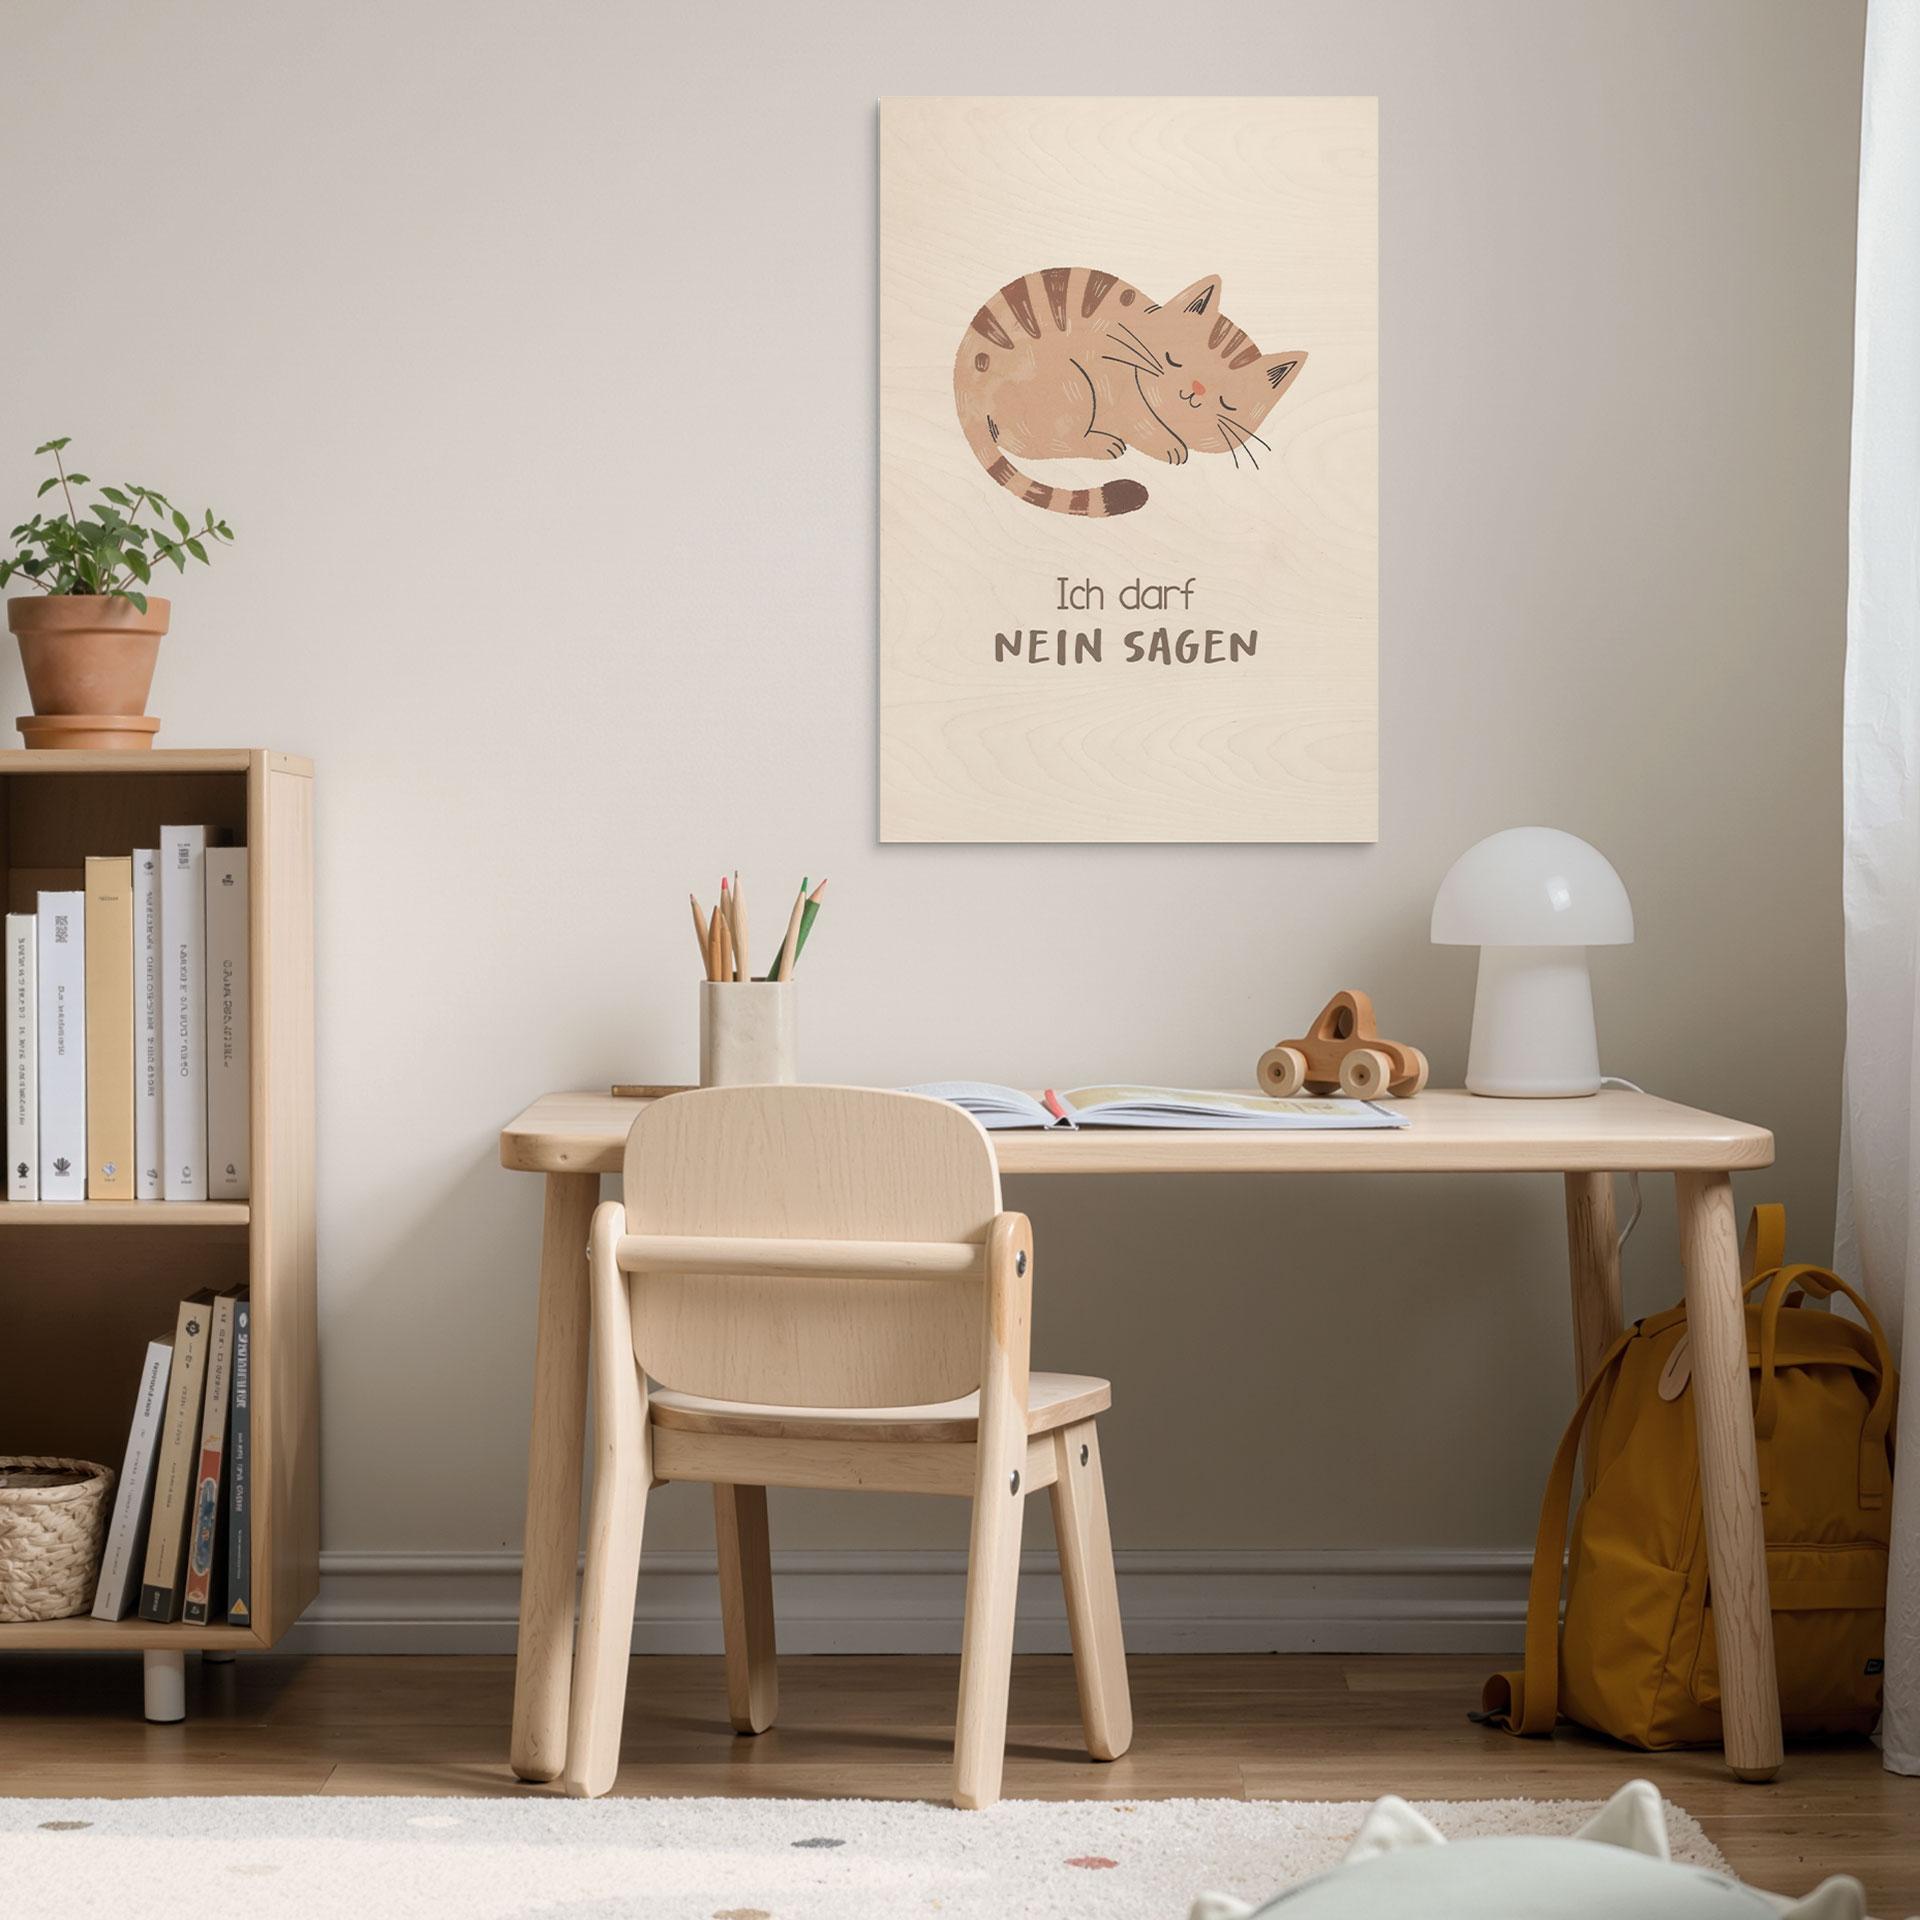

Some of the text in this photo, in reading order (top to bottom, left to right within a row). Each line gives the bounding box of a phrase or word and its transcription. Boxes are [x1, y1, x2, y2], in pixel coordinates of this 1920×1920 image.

[1056, 577, 1197, 610] Ich darf
[995, 627, 1258, 666] NEIN SAGEN
